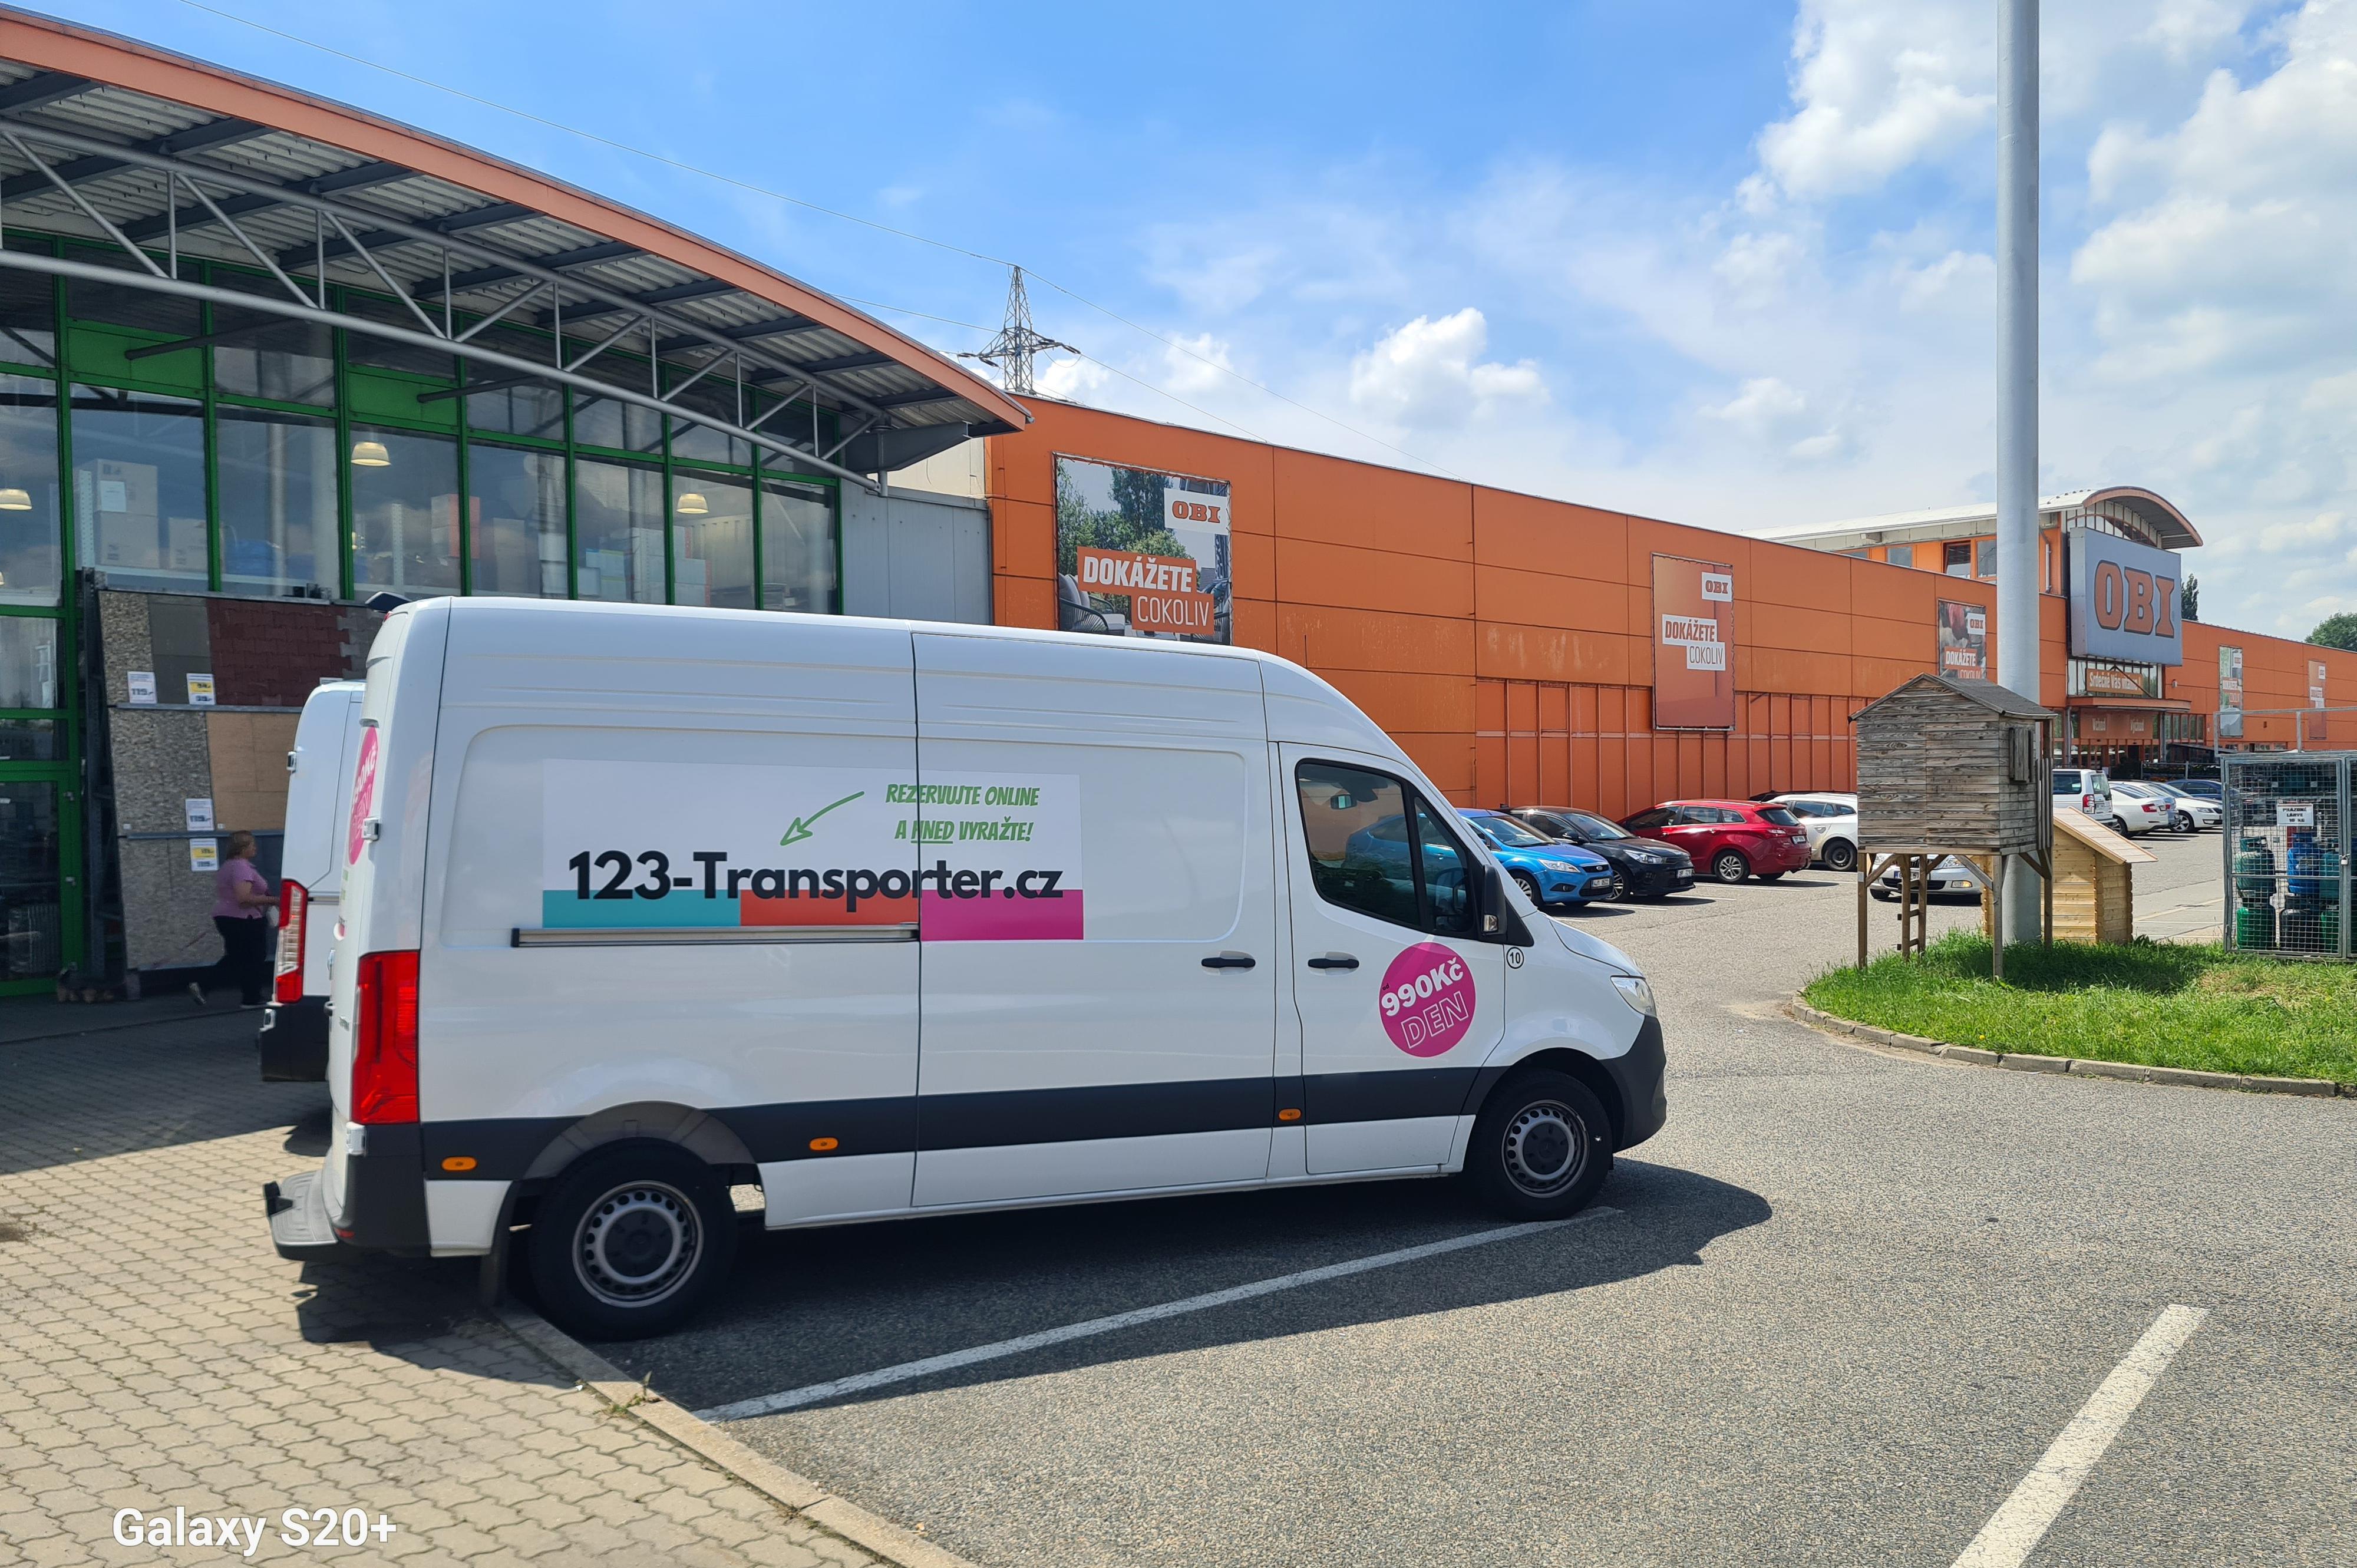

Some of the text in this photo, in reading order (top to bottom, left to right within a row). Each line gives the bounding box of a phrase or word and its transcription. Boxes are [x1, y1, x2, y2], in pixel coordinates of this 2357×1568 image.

[1171, 500, 1221, 523] OBI
[1083, 556, 1193, 592] DOKÁŽETE
[1705, 580, 1728, 594] OBI
[2094, 560, 2174, 638] OBI
[1137, 596, 1209, 626] COKOLIV
[1665, 620, 1715, 642] DOKÁŽETE
[1970, 619, 1983, 629] OBI
[1689, 646, 1723, 664] COKOLIV
[1946, 649, 1976, 666] DOKÁŽETE
[885, 784, 1041, 806] REZERVUJTE ONLINE
[894, 816, 1034, 841] A HNED VYRAŽTE!
[569, 850, 1064, 913] 123-Transporter.cz
[1510, 952, 1521, 964] 10
[1381, 957, 1464, 1016] 990Kč
[1401, 991, 1469, 1049] DEN
